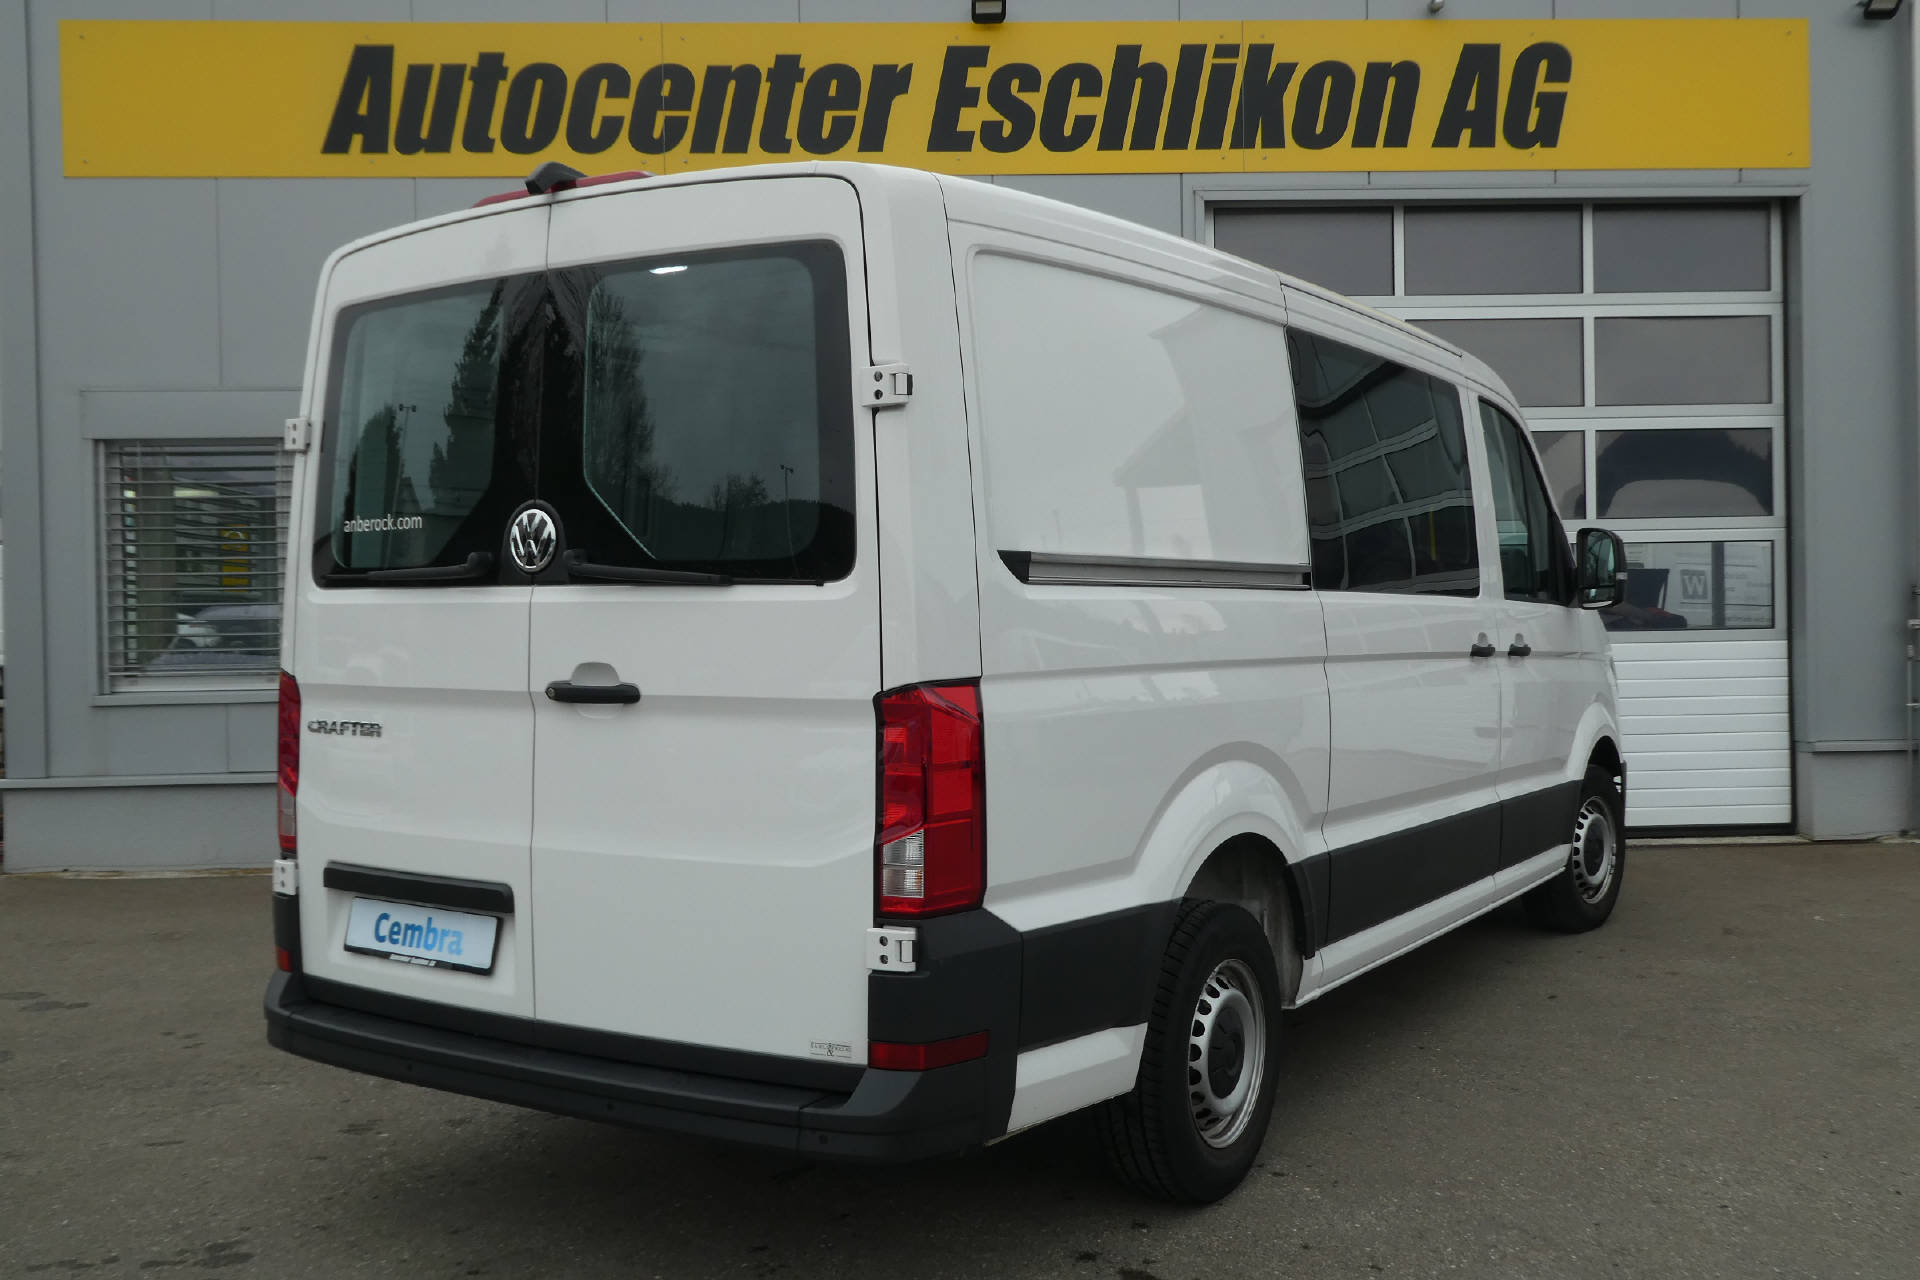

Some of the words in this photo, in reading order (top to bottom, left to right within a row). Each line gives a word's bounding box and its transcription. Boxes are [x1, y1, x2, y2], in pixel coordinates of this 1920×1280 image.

[319, 44, 914, 156] Autocenter
[926, 43, 1421, 153] Eschlikon
[1431, 41, 1573, 150] AG
[343, 513, 423, 533] anberock.com
[510, 508, 557, 572] VW
[307, 720, 383, 738] CRAFTER
[374, 911, 464, 956] Cembra
